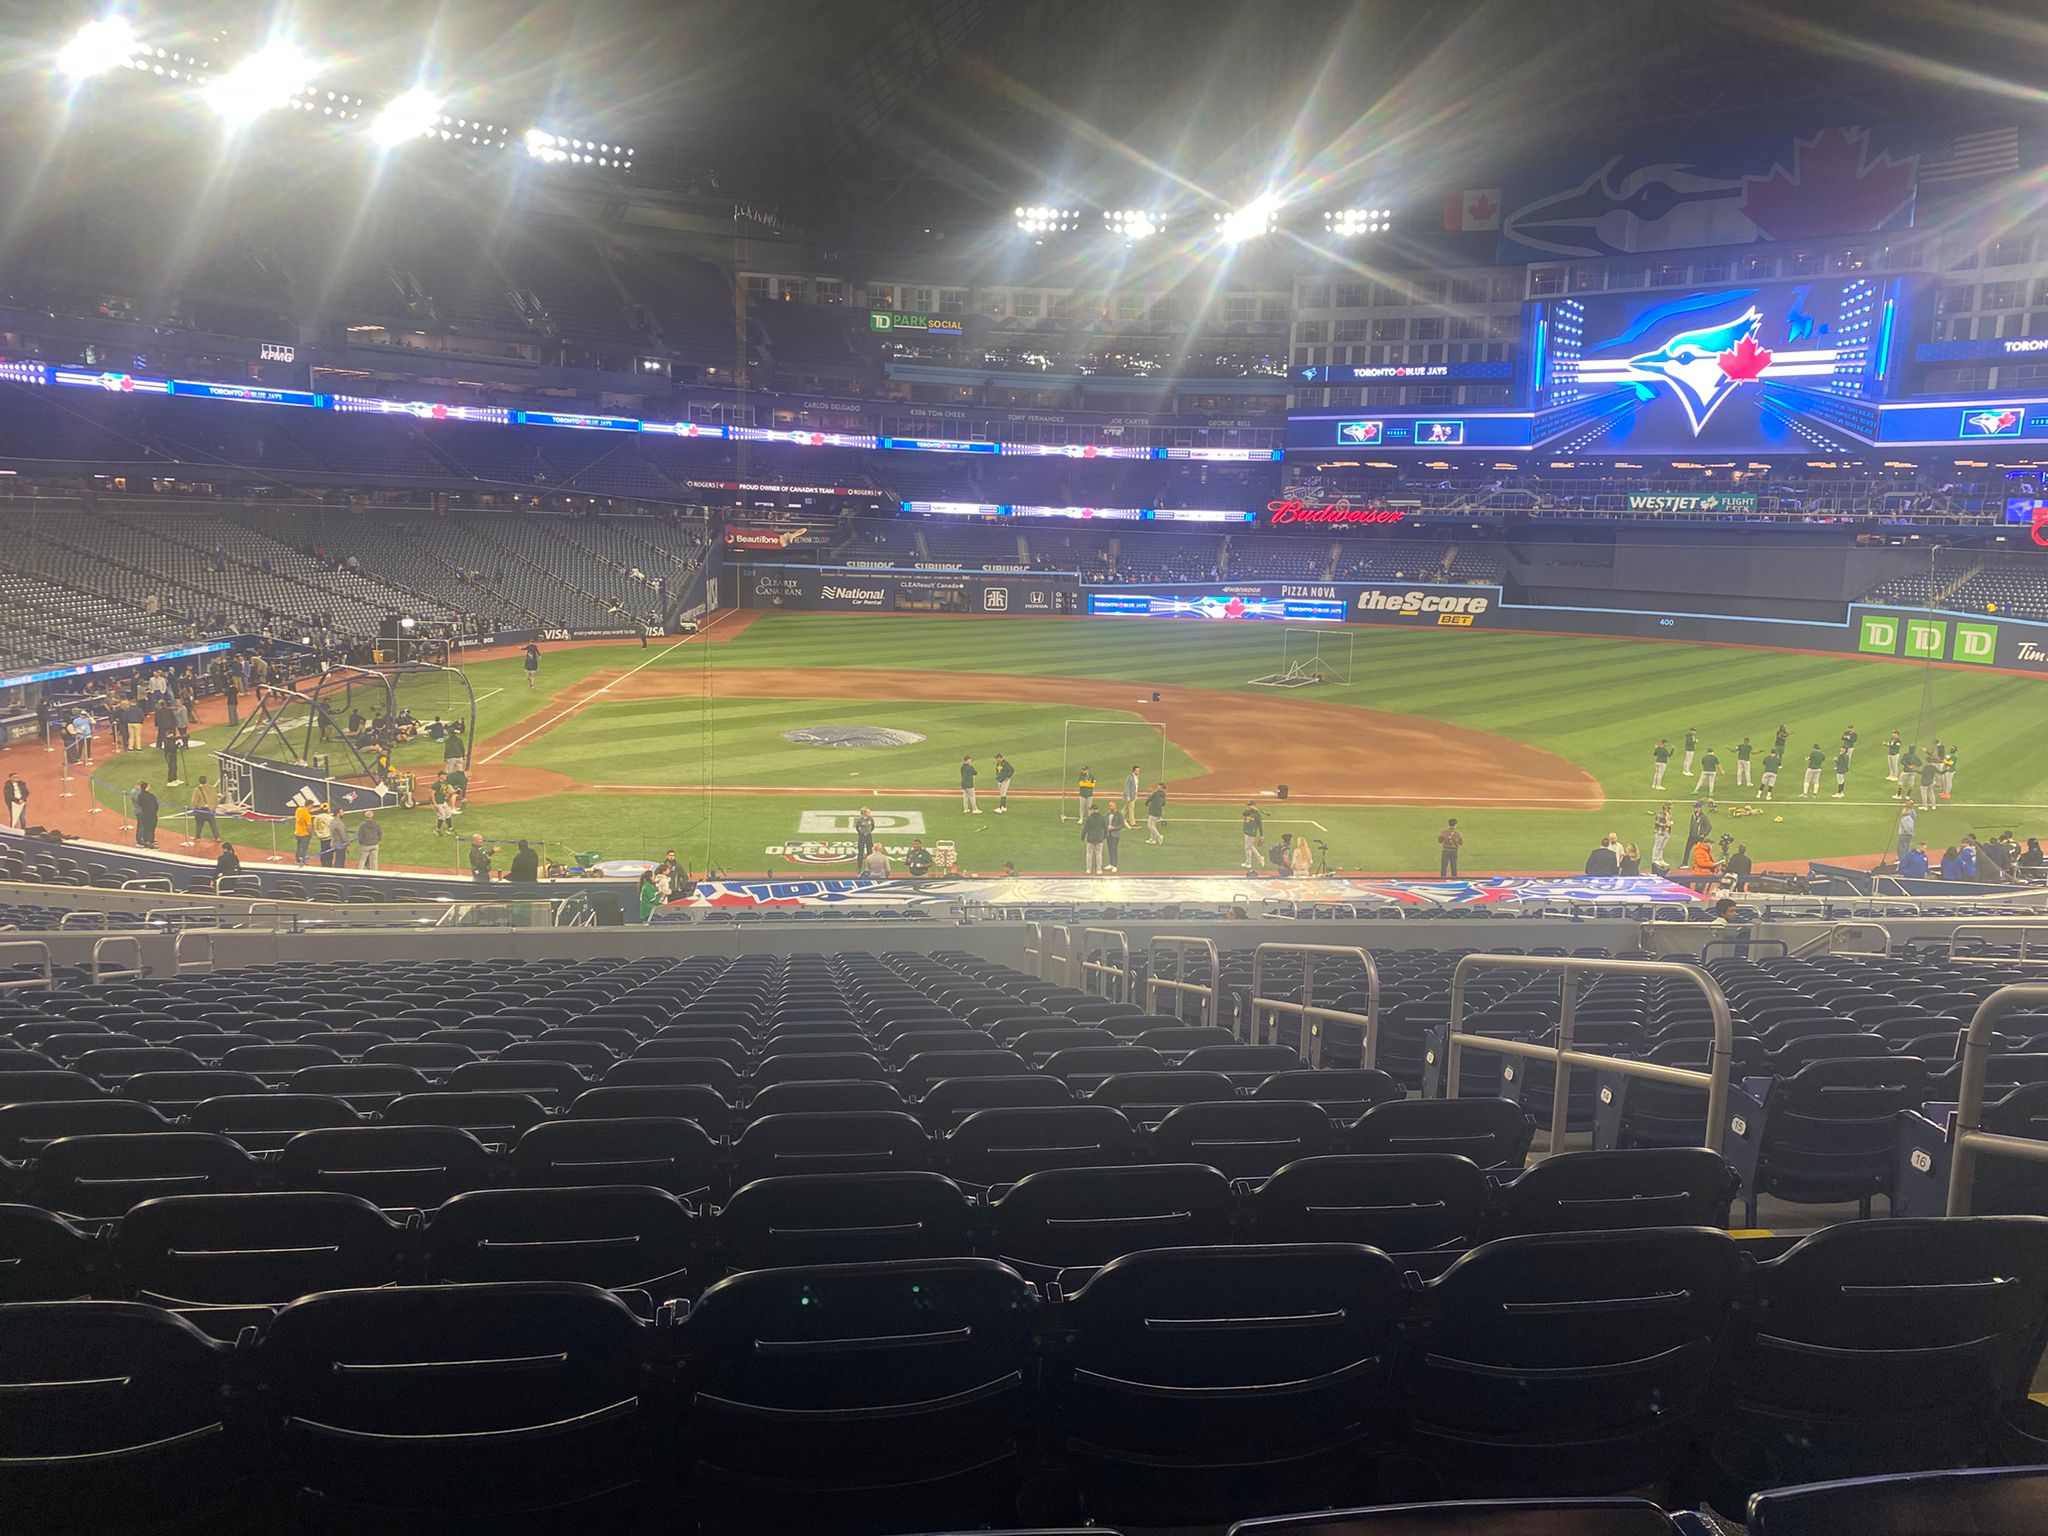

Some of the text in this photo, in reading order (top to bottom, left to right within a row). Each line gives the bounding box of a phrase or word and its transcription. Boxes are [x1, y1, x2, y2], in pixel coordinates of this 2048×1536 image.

[872, 314, 963, 330] TD PARK SOCIAL
[260, 350, 294, 363] KPMG
[1353, 366, 1448, 377] TORONTO BLUE JAYS
[208, 387, 282, 401] TORONTO BLUE JAYS
[803, 401, 861, 412] CARLOS DELGADO
[552, 416, 580, 425] TORONTO
[1027, 415, 1064, 423] FERNANDEZ
[693, 481, 716, 489] ROGERS
[739, 483, 759, 491] PROUD
[789, 486, 818, 494] CANADA'S
[818, 487, 834, 495] TEAM
[853, 489, 874, 497] ROGERS
[1629, 496, 1700, 512] WESTJET
[1721, 497, 1755, 506] FLIGHT
[1266, 500, 1406, 524] Budweiser
[1281, 585, 1336, 599] PIZZA NOVA
[1357, 590, 1488, 614] theScore
[1440, 615, 1471, 624] BET
[1659, 618, 1674, 626] 400
[543, 629, 570, 641] VISA
[573, 630, 602, 638] everywhere
[602, 630, 612, 638] you
[1866, 622, 1894, 646] TD
[1911, 626, 1941, 651] TD
[1960, 630, 1992, 656] TD
[2017, 642, 2046, 662] Tim
[1735, 1120, 1744, 1132] 15
[1916, 1155, 1927, 1168] 16
